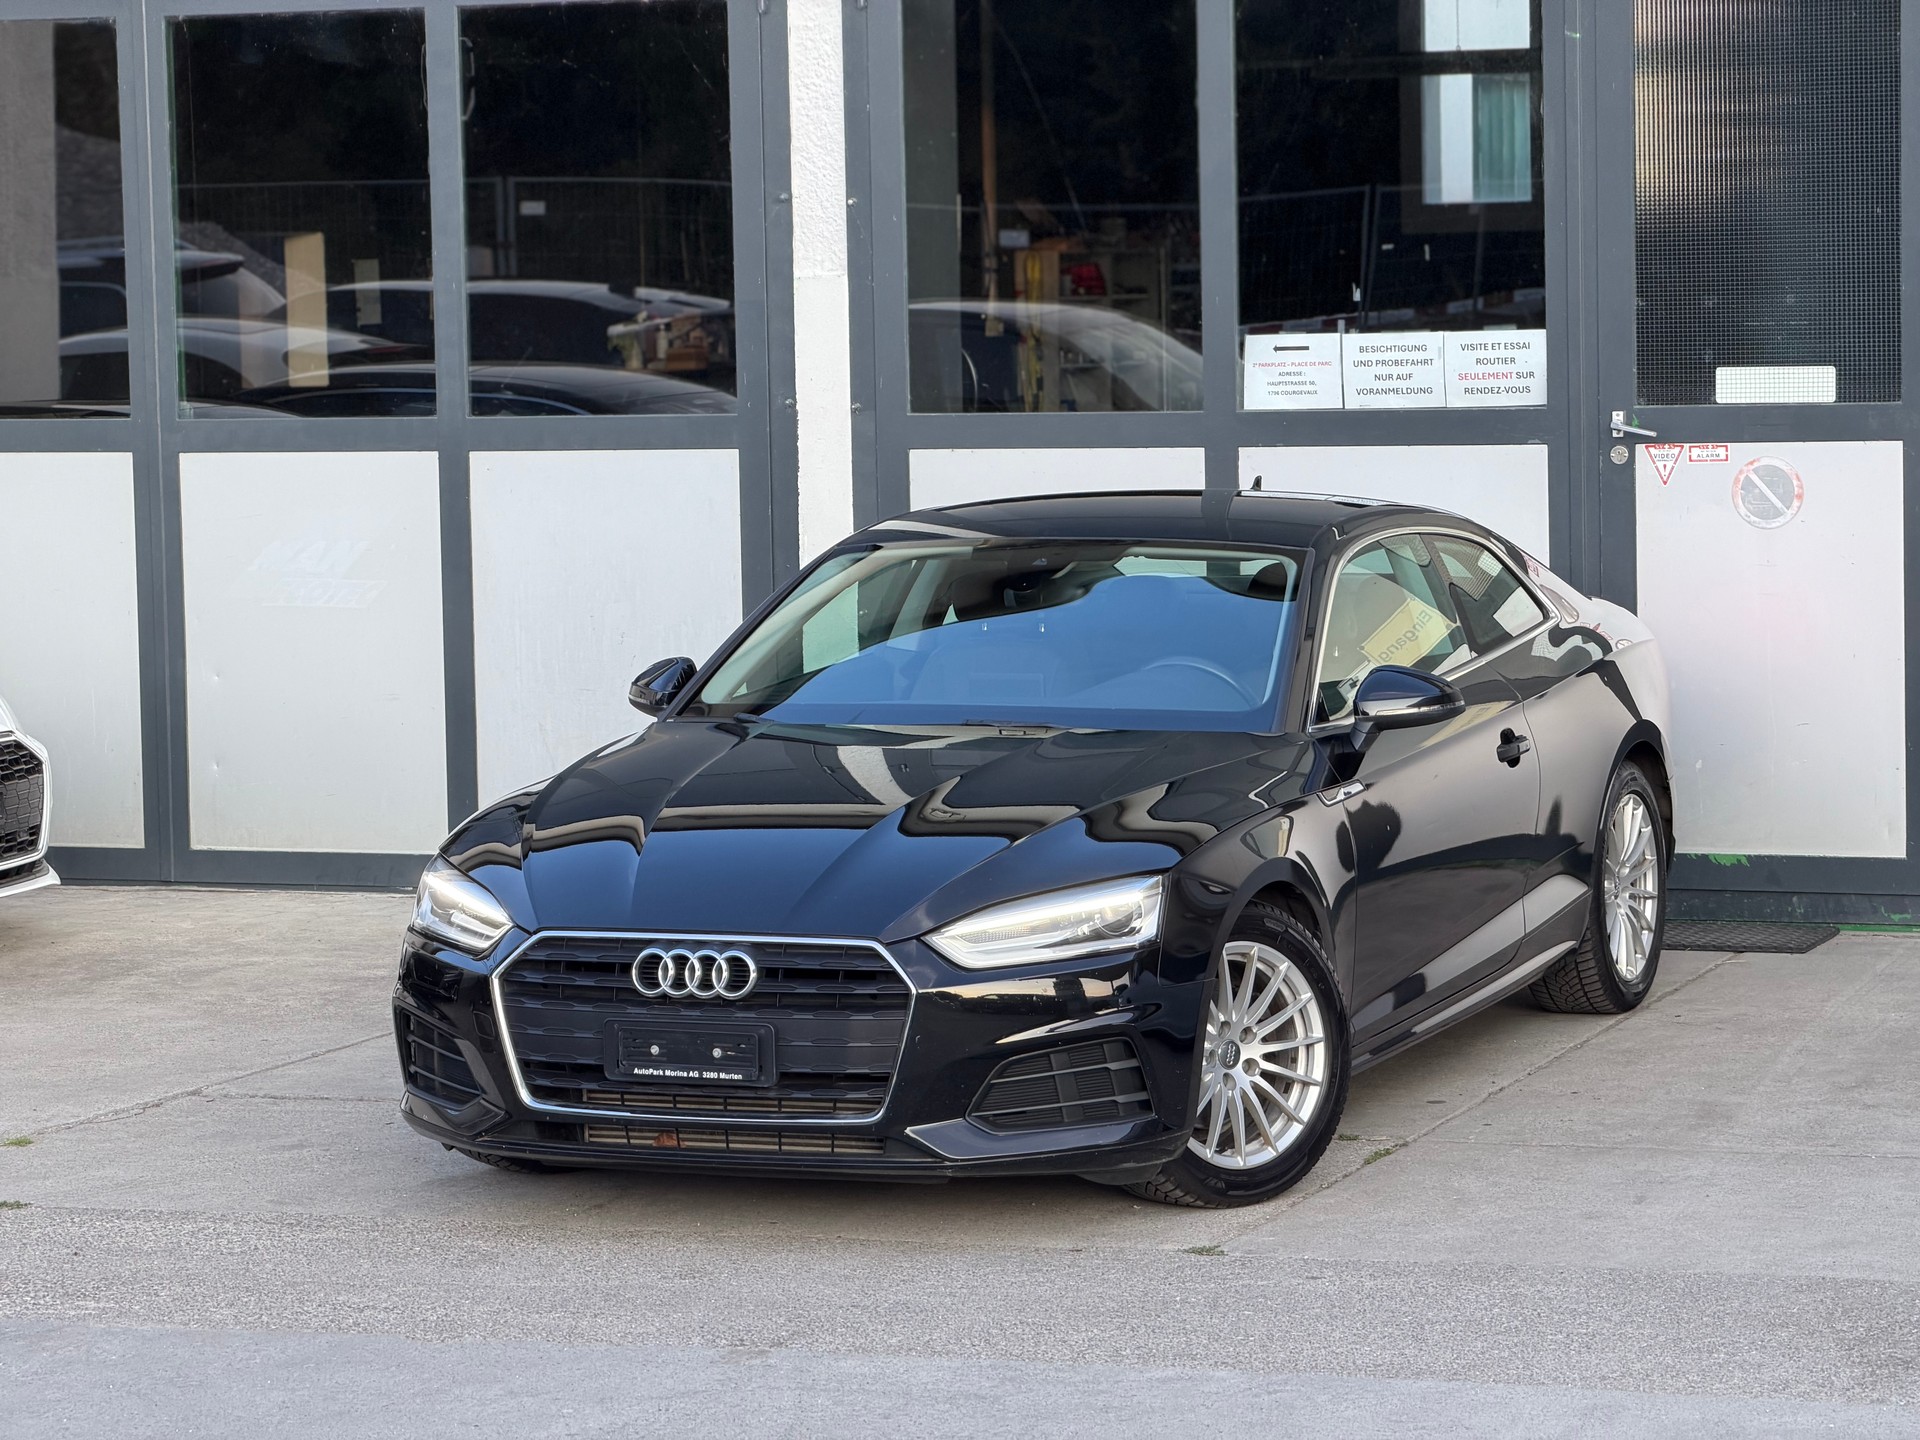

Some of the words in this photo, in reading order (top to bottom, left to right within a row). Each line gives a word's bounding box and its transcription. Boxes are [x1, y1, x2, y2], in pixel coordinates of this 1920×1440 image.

[1359, 344, 1428, 353] BESICHTIGUNG
[1460, 343, 1489, 351] VISITE
[1491, 342, 1502, 351] ET
[1504, 342, 1531, 350] ESSAI
[1353, 359, 1374, 367] UND
[1375, 358, 1434, 367] PROBEFAHRT
[1475, 357, 1516, 366] ROUTIER
[1374, 373, 1394, 381] NUR
[1458, 372, 1513, 381] SEULEMENT
[1515, 371, 1535, 379] SUR
[1356, 387, 1433, 396] VORANMELDUNG
[1464, 386, 1531, 395] RENDEZ-VOUS
[634, 1067, 664, 1076] AutoPark
[664, 1069, 688, 1078] Morina
[719, 1072, 743, 1080] Murten
